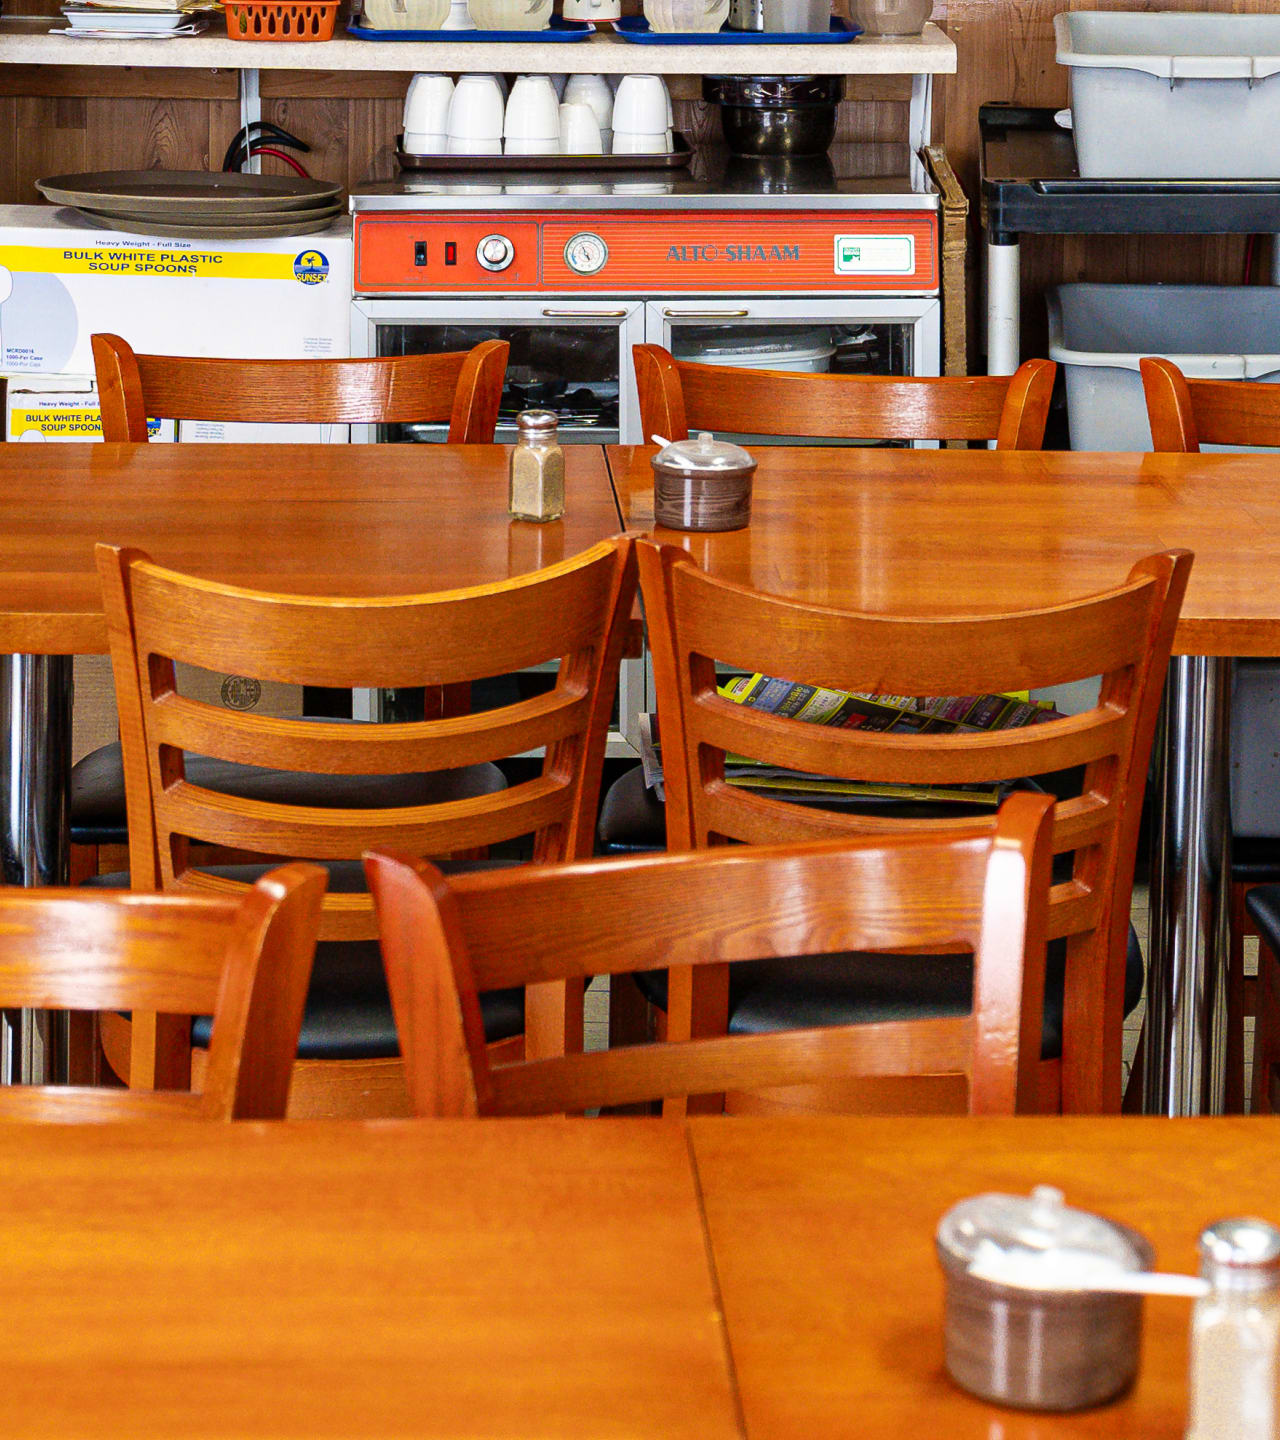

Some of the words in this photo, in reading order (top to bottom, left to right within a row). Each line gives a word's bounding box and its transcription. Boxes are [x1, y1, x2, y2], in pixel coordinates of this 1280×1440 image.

[122, 240, 150, 248] Weight
[665, 244, 800, 261] ALTO-SHAAM
[63, 251, 103, 261] BULK
[108, 252, 156, 262] WHITE
[160, 253, 224, 264] PLASTIC
[88, 262, 130, 272] SOUP
[134, 263, 198, 273] SPOONS
[297, 273, 328, 282] SUNSET
[25, 414, 50, 422] BULK
[53, 414, 82, 422] WHITE
[68, 424, 103, 432] SPOON
